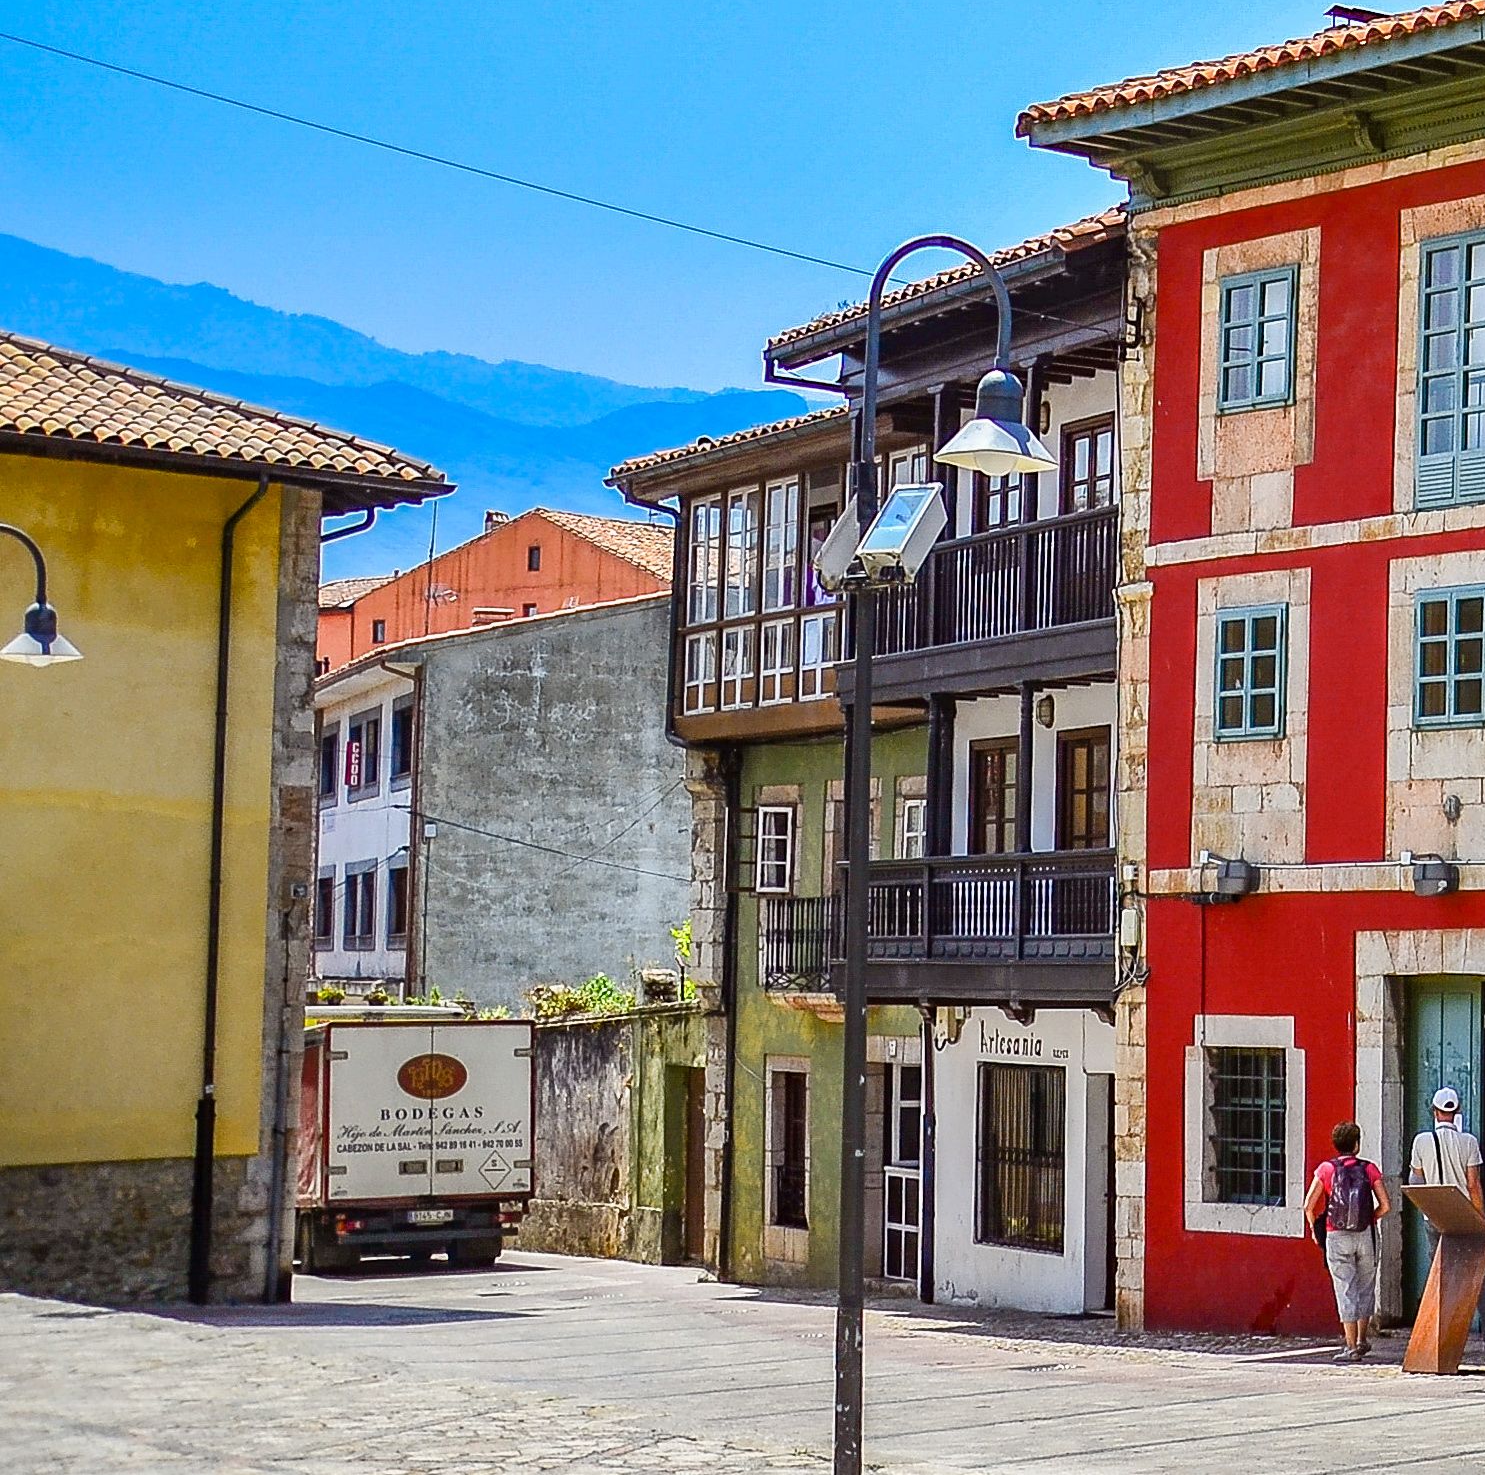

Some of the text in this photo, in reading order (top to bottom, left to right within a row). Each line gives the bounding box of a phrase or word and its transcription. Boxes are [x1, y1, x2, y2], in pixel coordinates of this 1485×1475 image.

[351, 742, 360, 786] CCOO
[380, 1106, 483, 1121] BODEGAS
[337, 1125, 366, 1143] Hijo
[368, 1126, 382, 1137] de
[383, 1124, 432, 1137] Martín
[336, 1143, 373, 1153] CABEZON
[374, 1143, 385, 1152] DE
[386, 1142, 397, 1152] LA
[397, 1141, 412, 1151] SAL
[435, 1141, 448, 1150] 942
[468, 1140, 476, 1149] 41
[482, 1140, 494, 1149] 942
[496, 1139, 504, 1148] 70
[505, 1139, 514, 1148] 00
[491, 1159, 497, 1167] S
